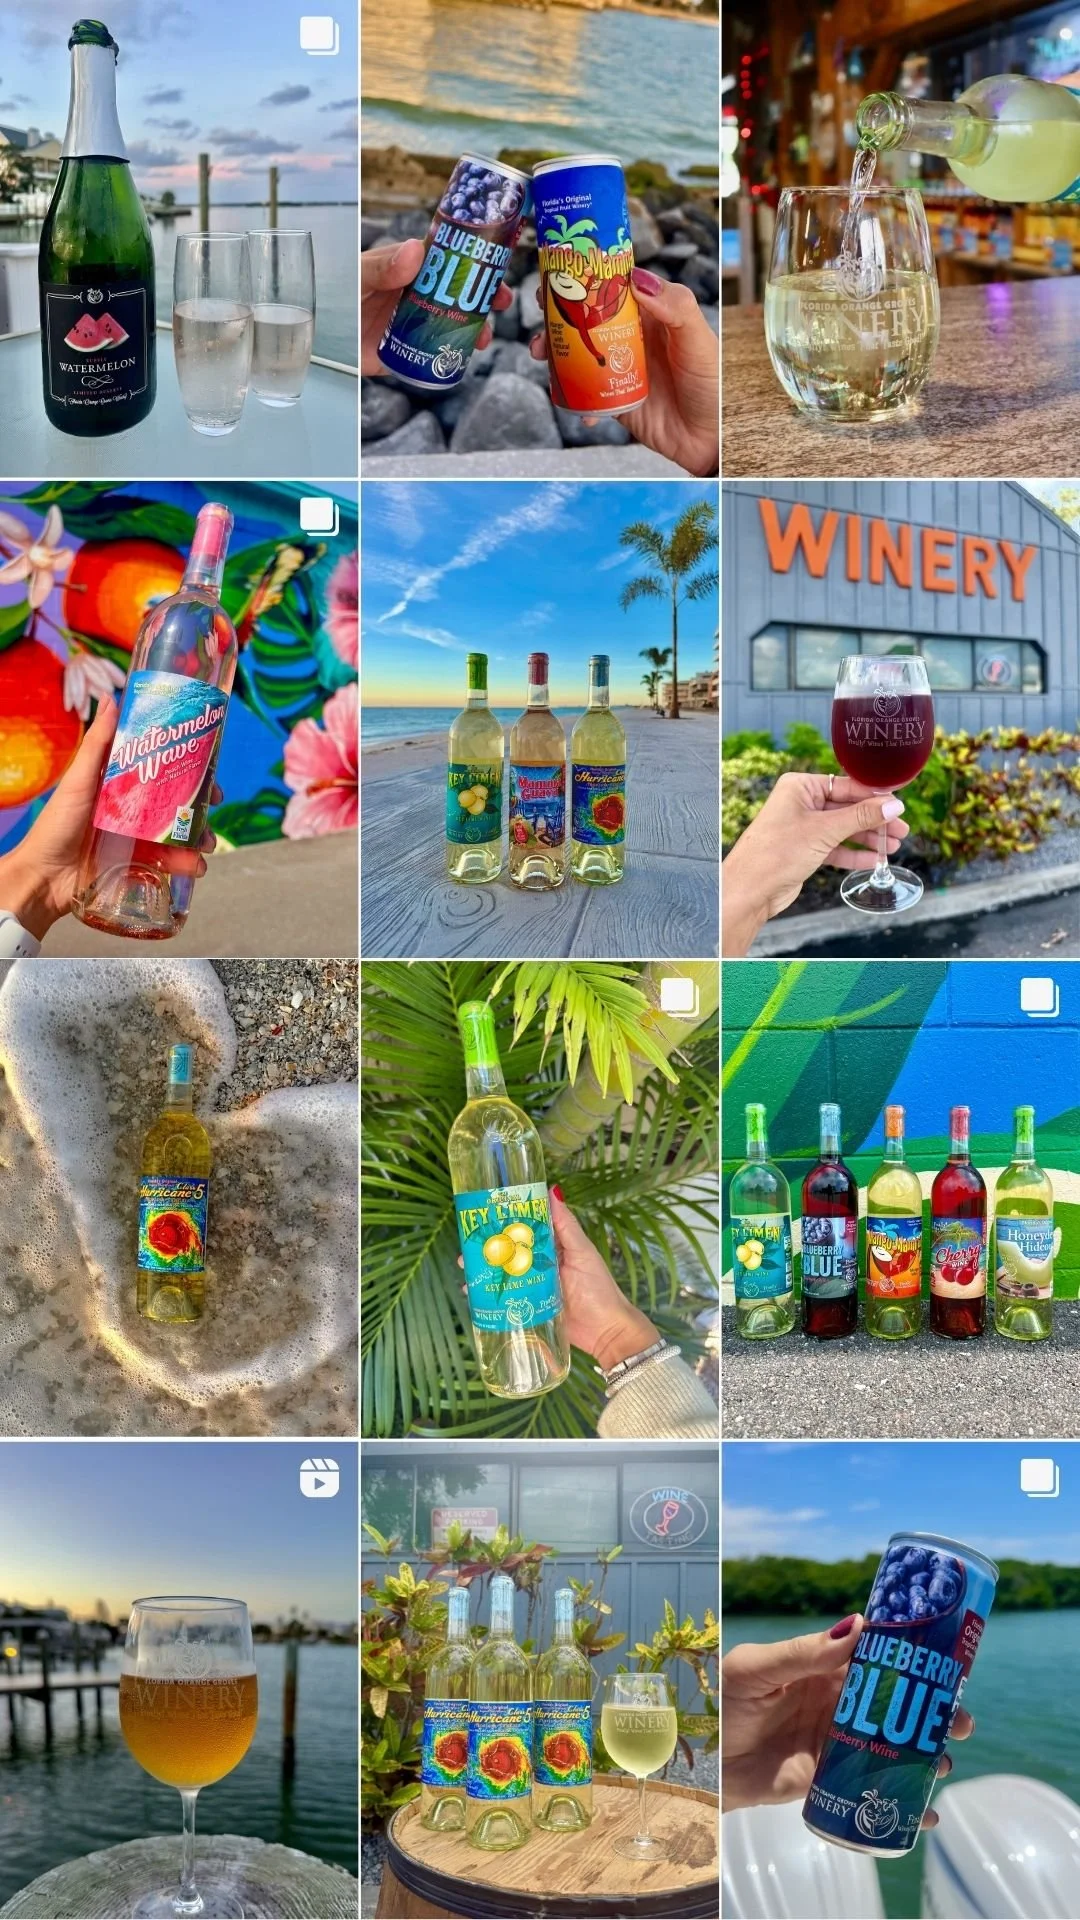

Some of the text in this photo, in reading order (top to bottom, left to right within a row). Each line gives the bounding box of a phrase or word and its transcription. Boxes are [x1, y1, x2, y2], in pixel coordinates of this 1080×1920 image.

[565, 192, 592, 204] Original
[413, 244, 506, 314] BLUE
[800, 301, 838, 312] FLORIDA
[840, 300, 882, 312] ORANGE
[446, 308, 469, 324] Wine
[598, 327, 636, 343] WINERY
[389, 340, 429, 367] WINERY
[59, 356, 136, 374] WATERMELON
[607, 369, 639, 390] Finally!
[759, 496, 1038, 603] WINERY
[110, 703, 225, 770] Watermelon
[845, 720, 926, 740] WINERY
[128, 737, 200, 785] Wave
[448, 771, 465, 789] KEY
[139, 1183, 206, 1200] Hurricane 5
[459, 1207, 490, 1240] KEY
[743, 1226, 780, 1243] LIMEN
[1008, 1228, 1053, 1244] Honeyde
[803, 1243, 844, 1256] BLUEBERRY
[936, 1244, 982, 1270] Cherry
[803, 1254, 843, 1278] BLUE
[951, 1260, 969, 1268] WINE
[484, 1272, 546, 1293] KEY LIME WINE
[474, 1312, 503, 1322] WINERY
[651, 1489, 690, 1504] WINE
[644, 1530, 694, 1545] TASTING
[854, 1630, 964, 1690] BLUEBERRY
[136, 1684, 246, 1710] WINERY
[424, 1707, 470, 1719] Hurrican
[468, 1710, 522, 1723] Hurricane
[523, 1707, 532, 1723] 5
[534, 1707, 581, 1719] Hurricane
[581, 1705, 591, 1720] 5
[833, 1662, 953, 1753] BLUE
[614, 1715, 671, 1729] WINERY
[828, 1725, 900, 1760] Blueberry Wine
[809, 1790, 852, 1818] WINERY
[819, 1788, 858, 1808] ORANGE GROVES
